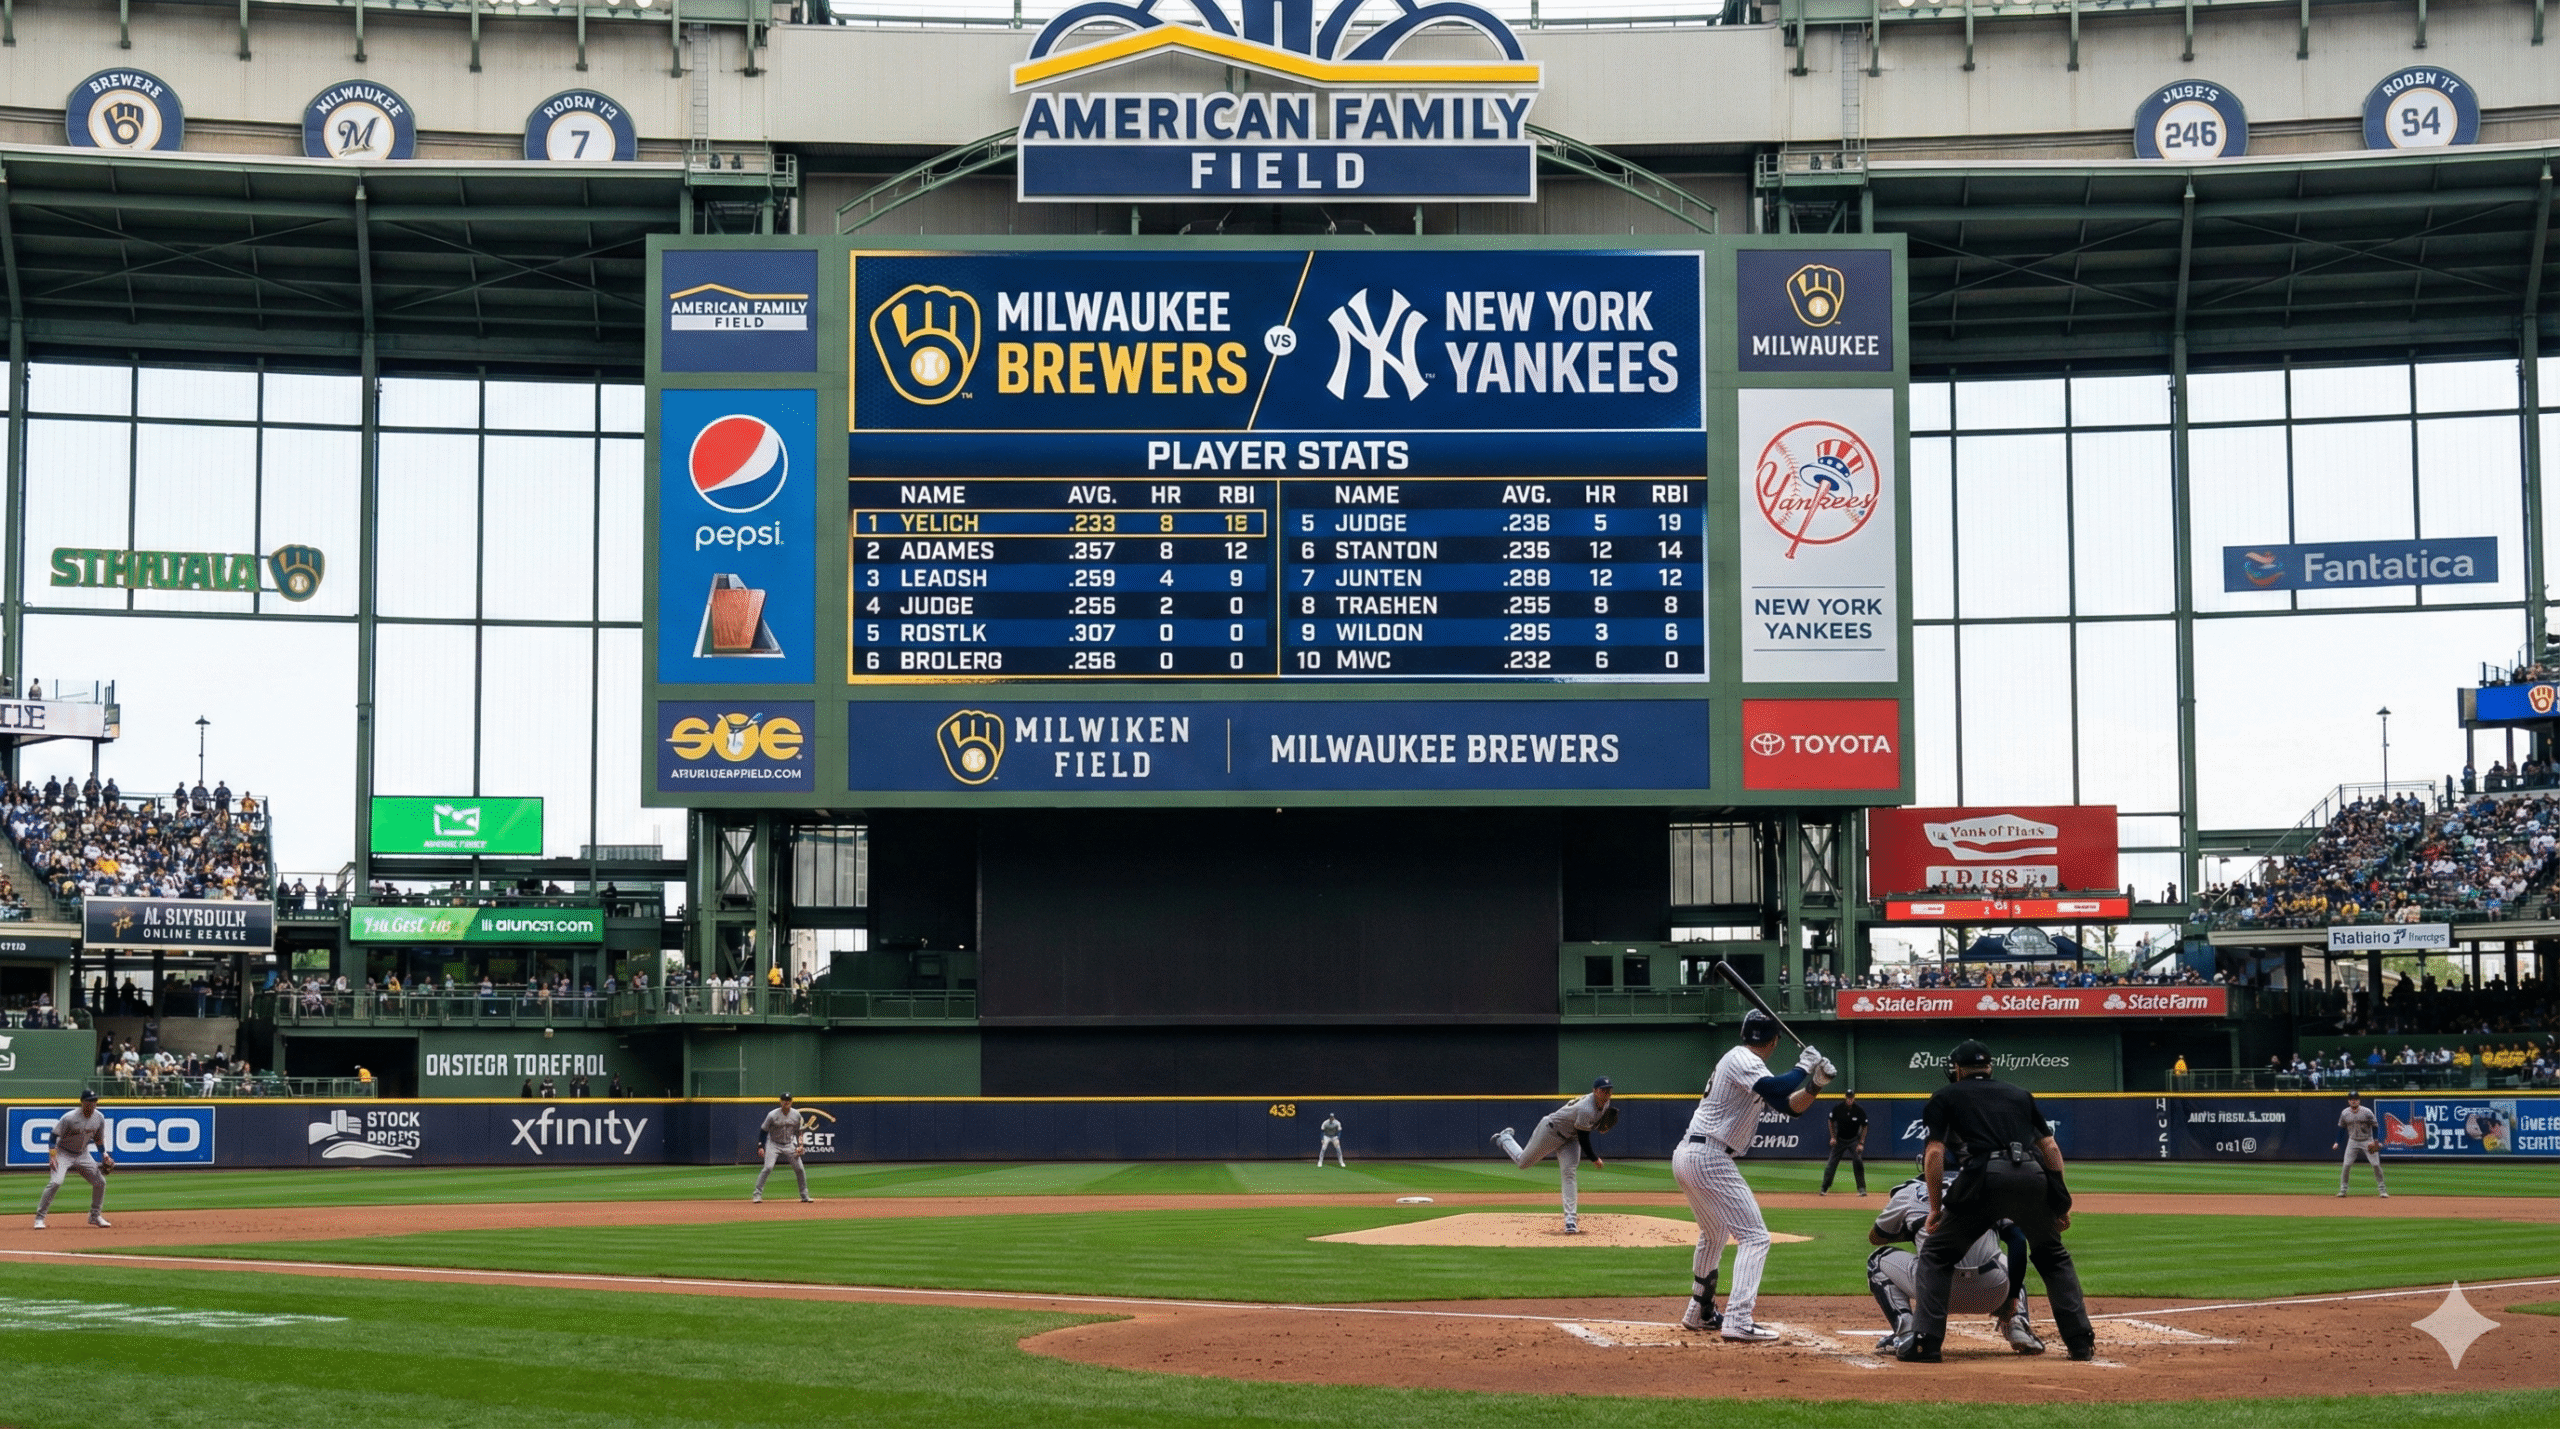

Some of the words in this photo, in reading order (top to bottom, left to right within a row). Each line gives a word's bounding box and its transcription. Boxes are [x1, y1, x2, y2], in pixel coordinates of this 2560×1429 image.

[89, 73, 163, 99] BREWERS
[315, 86, 404, 118] MILWAUKEE
[1023, 97, 1307, 140] AMERICAN
[1335, 97, 1528, 140] FAMILY
[571, 130, 590, 159] 7
[2164, 121, 2217, 149] 246
[1190, 152, 1365, 189] FIELD
[671, 301, 748, 314] AMERICAN
[754, 301, 808, 314] FAMILY
[997, 291, 1231, 332] MILWAUKEE
[1445, 290, 1533, 332] NEW
[1546, 290, 1653, 332] YORK
[715, 317, 764, 328] FIELD
[1270, 332, 1292, 349] VS
[1752, 335, 1879, 357] MILWAUKEE
[997, 341, 1248, 395] BREWERS
[1445, 340, 1679, 395] YANKEES
[1148, 441, 1288, 470] PLAYER
[1297, 441, 1410, 471] STATS
[900, 486, 966, 504] NAME
[1067, 485, 1117, 504] AVG.
[1151, 485, 1182, 504] HR
[1218, 485, 1255, 504] RBI
[1335, 485, 1400, 504] NAME
[1502, 485, 1552, 504] AVG.
[1585, 485, 1616, 503] HR
[1652, 485, 1688, 503] RBI
[868, 514, 877, 532] 1
[900, 514, 979, 532] YELICH
[1068, 514, 1116, 532] .233
[1301, 514, 1316, 532] 5
[1335, 514, 1407, 532] JUDGE
[1658, 514, 1683, 532] 19
[695, 521, 781, 552] pepsi
[867, 541, 880, 560] 2
[900, 541, 995, 560] ADAMES
[1159, 541, 1174, 560] 8
[1225, 541, 1248, 560] 12
[1301, 541, 1316, 560] 6
[1335, 541, 1438, 560] STANTON
[1590, 541, 1613, 560] 12
[1658, 541, 1683, 560] 14
[2304, 549, 2474, 583] Fantatica
[867, 569, 880, 587] 3
[1068, 569, 1116, 587] .259
[1159, 569, 1174, 587] 4
[1229, 569, 1244, 587] 9
[1301, 569, 1316, 587] 7
[1335, 569, 1422, 587] JUNTEN
[1590, 569, 1613, 587] 12
[1658, 569, 1683, 587] 12
[866, 596, 880, 615] 4
[900, 596, 974, 615] JUDGE
[1159, 596, 1174, 615] 2
[1229, 596, 1244, 615] 0
[1301, 596, 1316, 615] 8
[1755, 598, 1809, 616] NEW
[1817, 598, 1882, 616] YORK
[867, 624, 880, 642] 5
[900, 624, 987, 642] ROSTLK
[1068, 624, 1116, 642] .307
[1159, 624, 1174, 642] 0
[1229, 624, 1244, 642] 0
[1301, 623, 1316, 642] 9
[1503, 623, 1551, 642] .295
[1594, 623, 1609, 642] 3
[1665, 623, 1678, 642] 6
[1763, 622, 1872, 641] YANKEES
[867, 652, 880, 670] 6
[1159, 652, 1174, 670] 0
[1229, 652, 1244, 670] 0
[1297, 651, 1321, 669] 10
[1335, 651, 1391, 669] MWC
[1503, 651, 1551, 669] .232
[1594, 651, 1609, 669] 6
[1665, 651, 1678, 669] 0
[1015, 716, 1190, 742] MILWIKEN
[1271, 734, 1457, 763] MILWAUKEE
[1467, 734, 1620, 763] BREWERS
[1792, 735, 1892, 754] TOYOTA
[1054, 751, 1151, 777] FIELD
[143, 928, 192, 939] ONLINE
[366, 1111, 421, 1127] STOCK
[510, 1107, 648, 1156] xfinity
